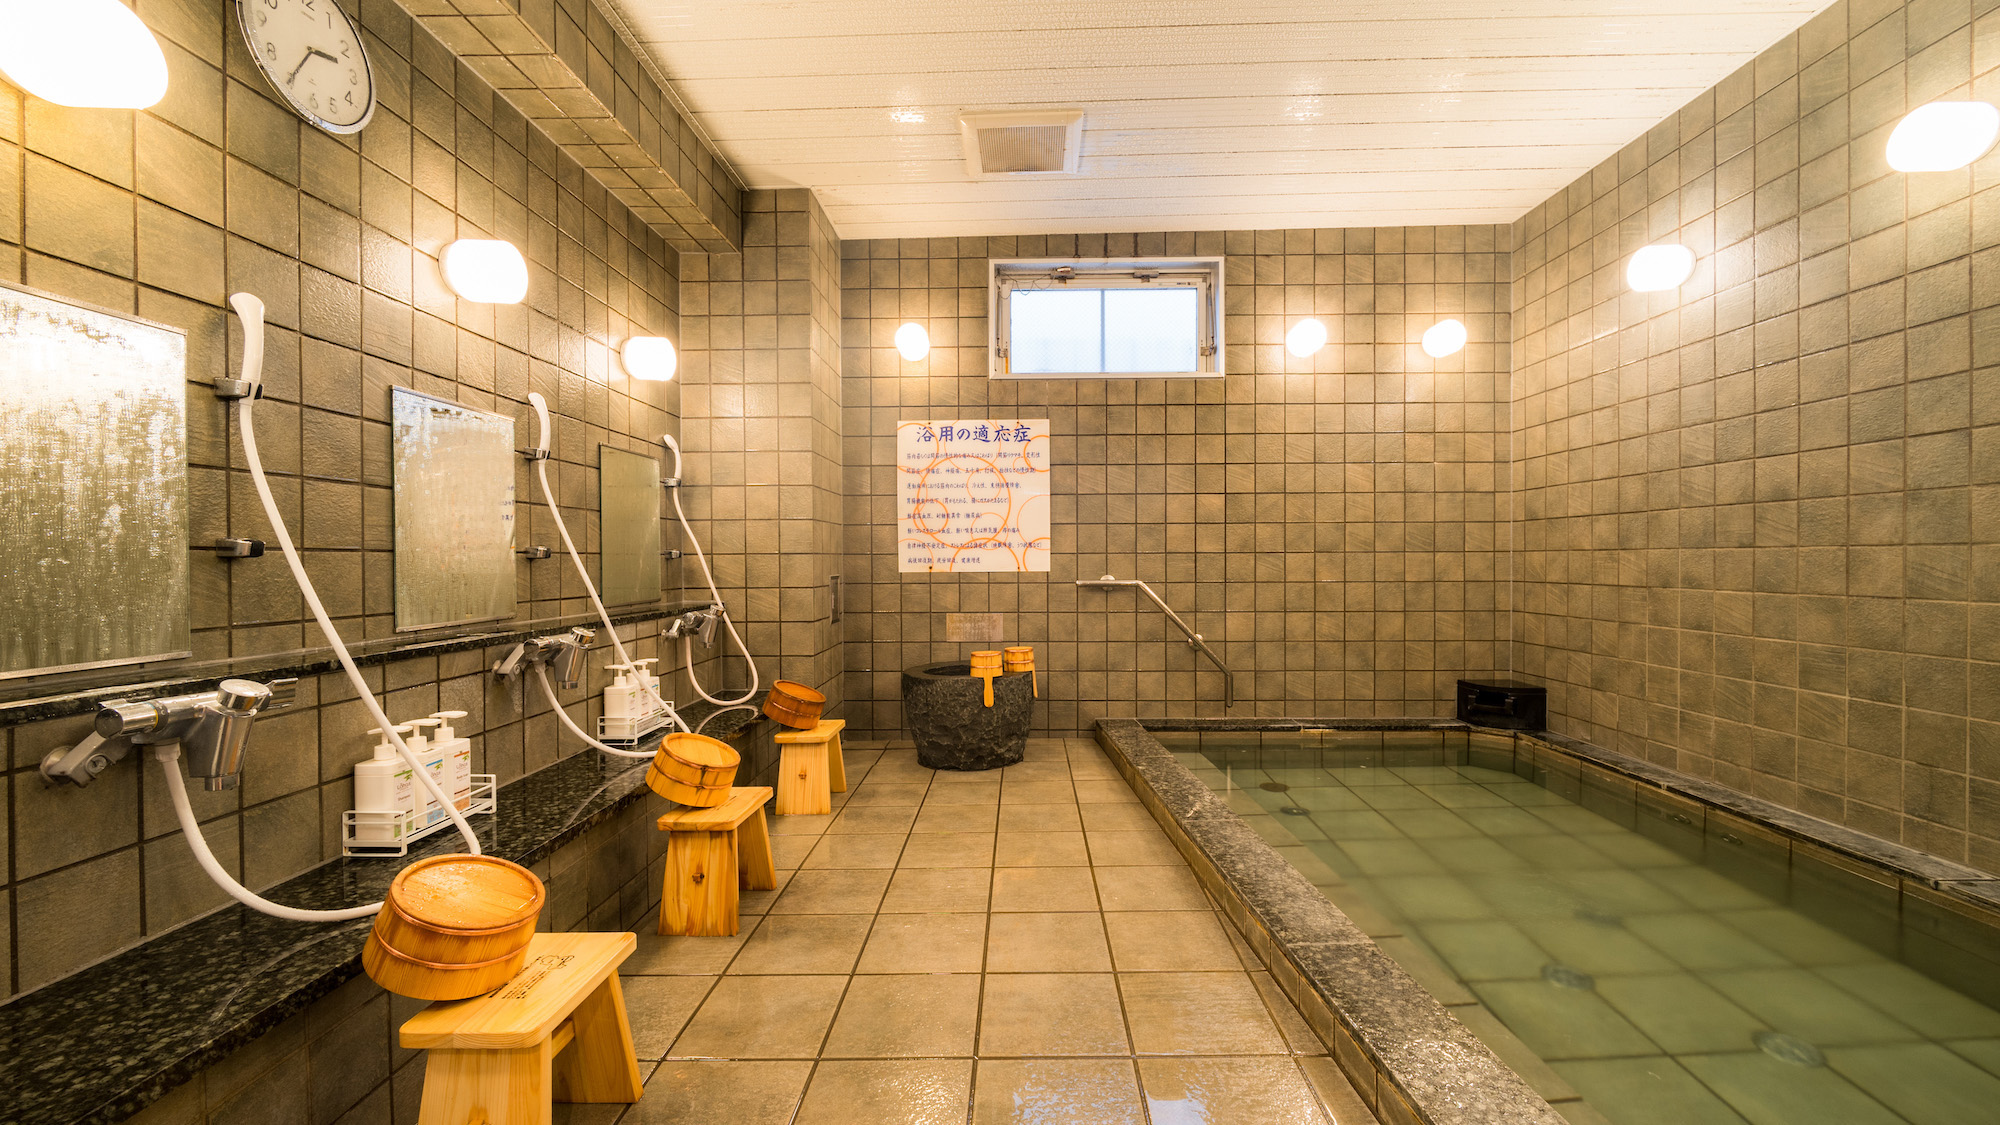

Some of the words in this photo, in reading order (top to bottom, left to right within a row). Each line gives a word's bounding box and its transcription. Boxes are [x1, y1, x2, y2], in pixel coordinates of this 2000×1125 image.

[257, 10, 267, 27] 9
[326, 11, 332, 29] 1
[266, 42, 277, 61] 8
[340, 40, 350, 58] 2
[349, 69, 358, 86] 3
[310, 93, 319, 110] 6
[330, 96, 338, 114] 5
[344, 90, 354, 107] 4
[916, 424, 1032, 443] 浴用の適応症
